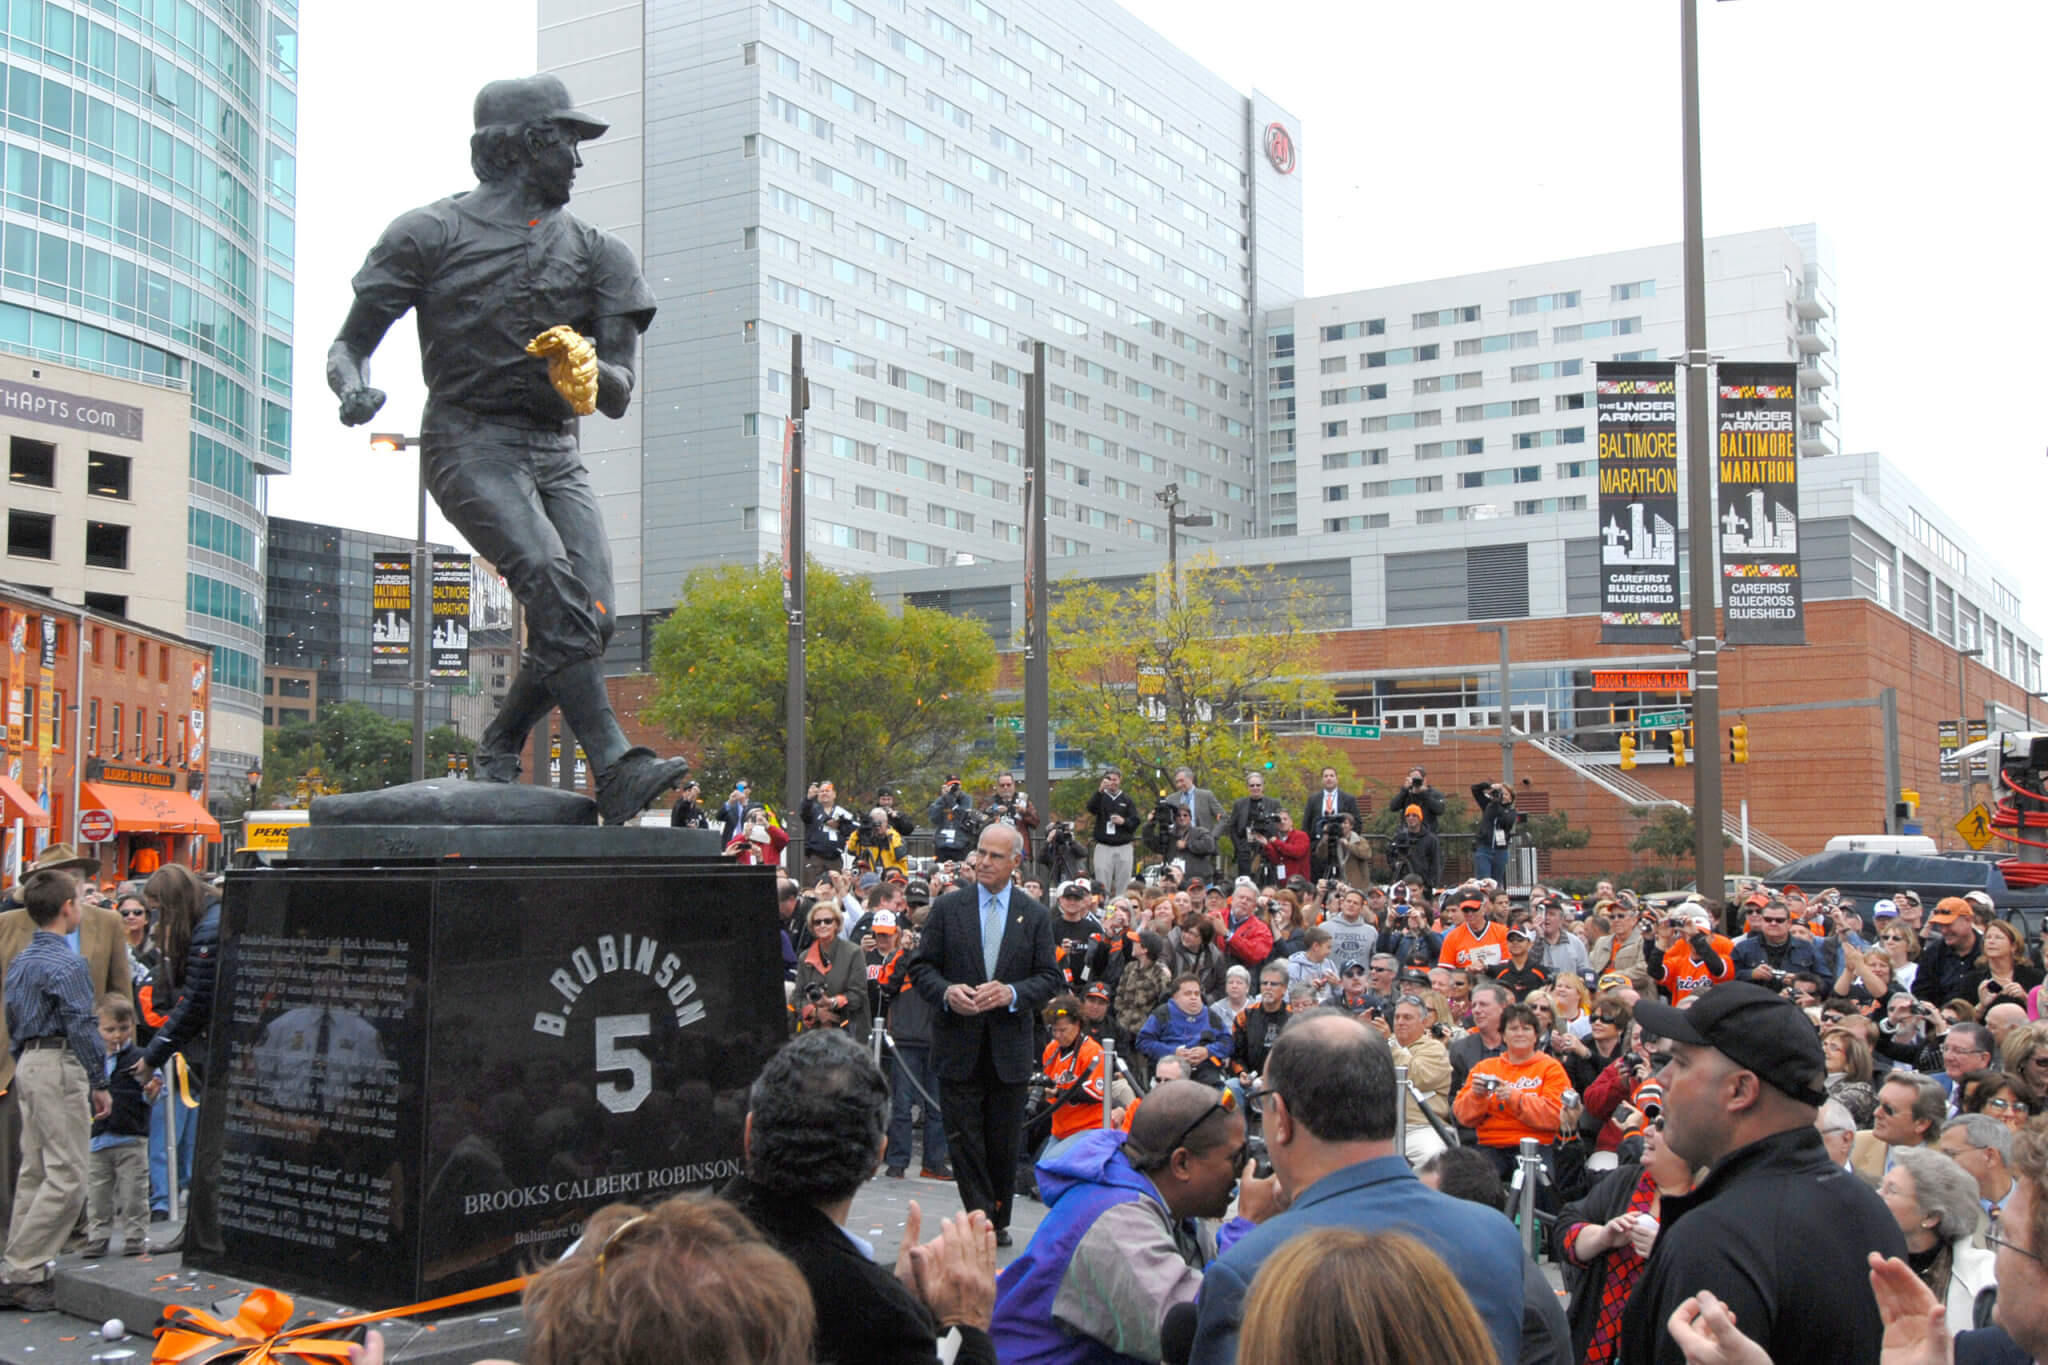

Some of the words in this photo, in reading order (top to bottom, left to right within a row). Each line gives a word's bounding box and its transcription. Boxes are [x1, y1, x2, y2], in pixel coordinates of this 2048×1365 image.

[1615, 401, 1675, 411] UNDER
[1599, 412, 1675, 422] ARMOUR
[1736, 411, 1792, 421] UNDER
[1721, 421, 1793, 431] ARMOUR
[1600, 433, 1677, 459] BALTIMORE
[1720, 433, 1794, 458] BALTIMORE
[1720, 460, 1795, 484] MARATHON
[1600, 468, 1677, 494] MARATHON
[1610, 574, 1670, 583] CAREFIRST
[1608, 584, 1672, 593] BLUECROSS
[1731, 583, 1790, 594] CAREFIRST
[1607, 594, 1674, 603] BLUESHIELD
[1729, 596, 1795, 607] BLUECROSS
[1729, 608, 1796, 619] BLUESHIELD
[1595, 673, 1624, 688] BROOKS
[1626, 673, 1662, 688] ROBINSON
[1664, 673, 1688, 688] PLAZA
[254, 828, 289, 837] PENS
[595, 1013, 652, 1114] 5
[464, 1184, 550, 1215] BROOKS
[554, 1172, 643, 1200] CALBERT
[515, 1227, 569, 1245] Baltimore
